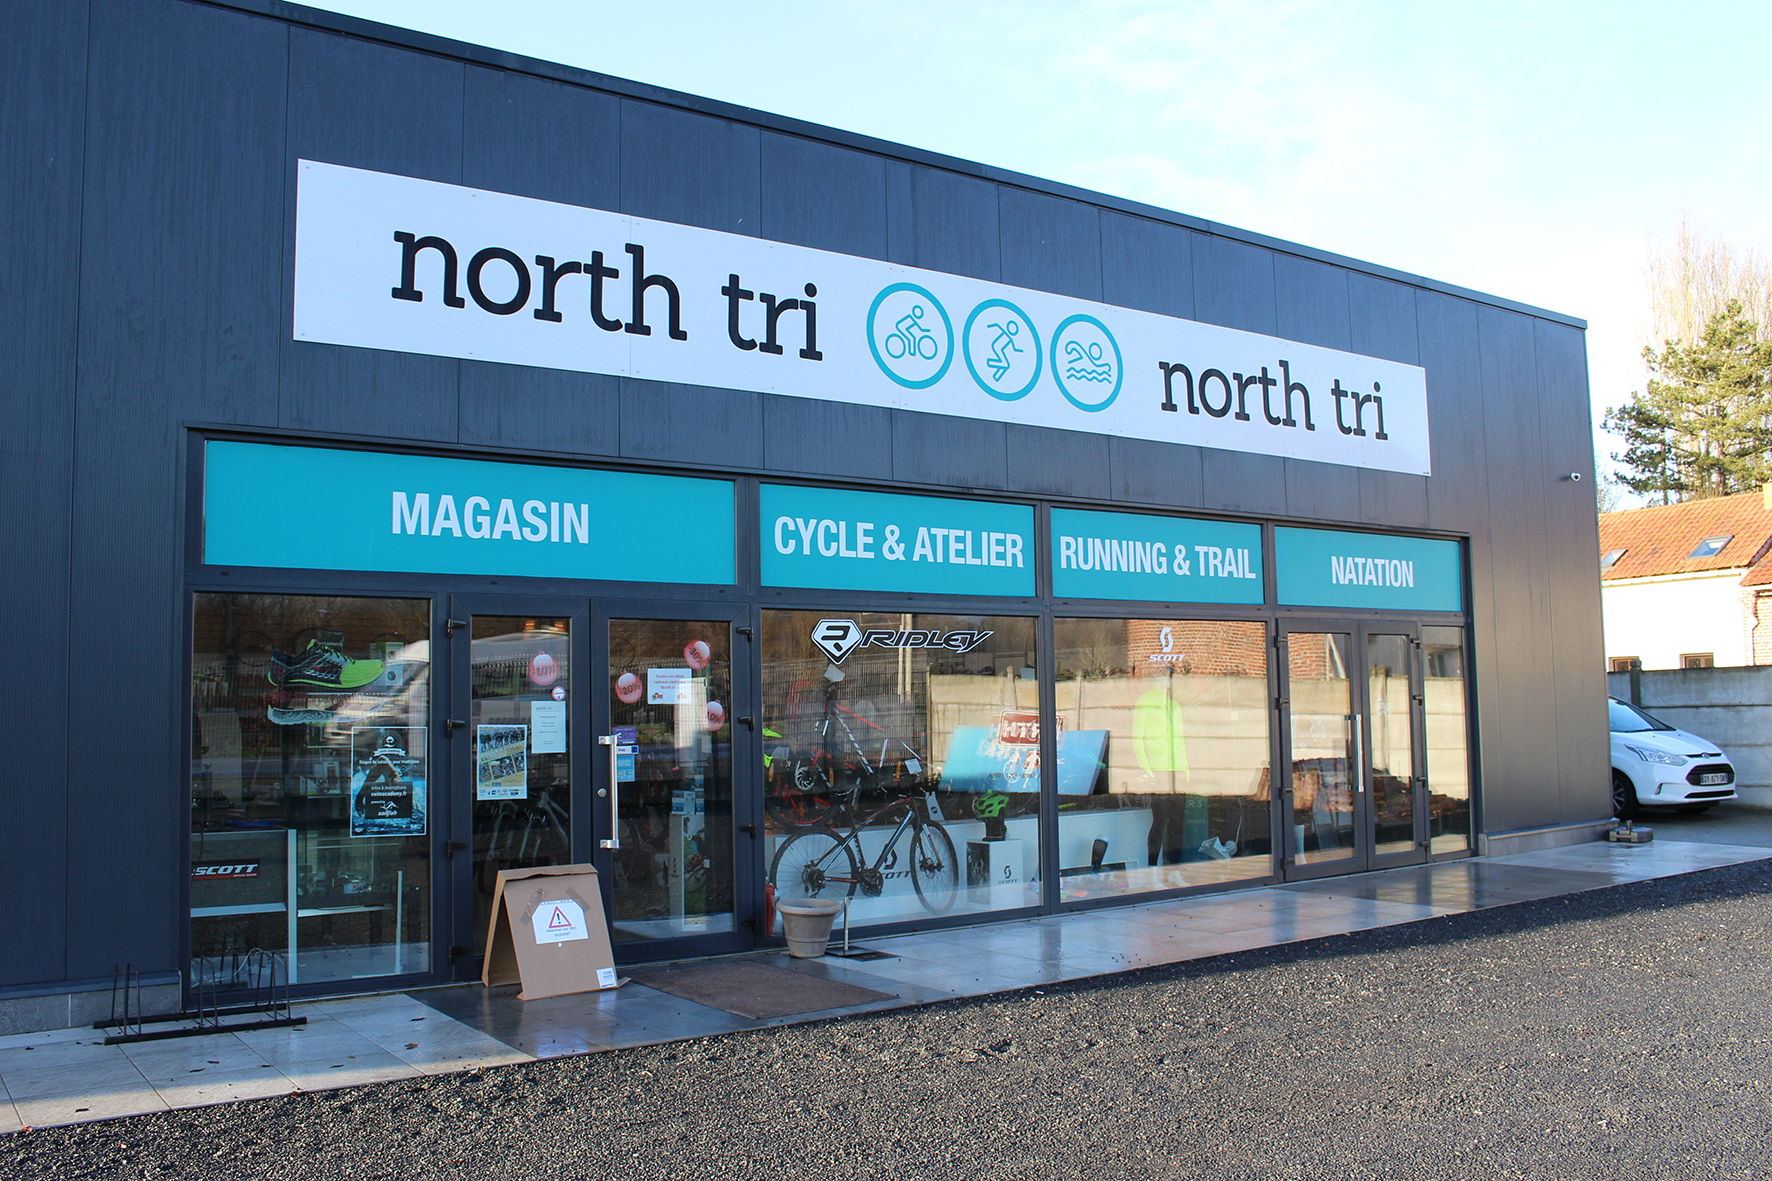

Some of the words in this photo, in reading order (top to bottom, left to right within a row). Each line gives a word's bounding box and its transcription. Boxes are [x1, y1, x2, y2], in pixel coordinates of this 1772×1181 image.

[391, 230, 688, 341] north
[721, 273, 823, 361] tri
[1158, 359, 1316, 432] north
[1330, 378, 1388, 441] tri
[392, 491, 589, 544] MAGASIN
[774, 516, 875, 558] CYCLE
[882, 524, 906, 561] &
[912, 526, 1024, 568] ATELIER
[1060, 535, 1168, 575] RUNNING
[1173, 544, 1191, 576] &
[1194, 545, 1257, 579] TRAIL
[1331, 556, 1415, 588] NATATION
[860, 629, 995, 654] RIDLEY
[1148, 654, 1186, 662] SCOTT
[619, 682, 640, 696] -20%
[195, 864, 258, 876] SCOTT
